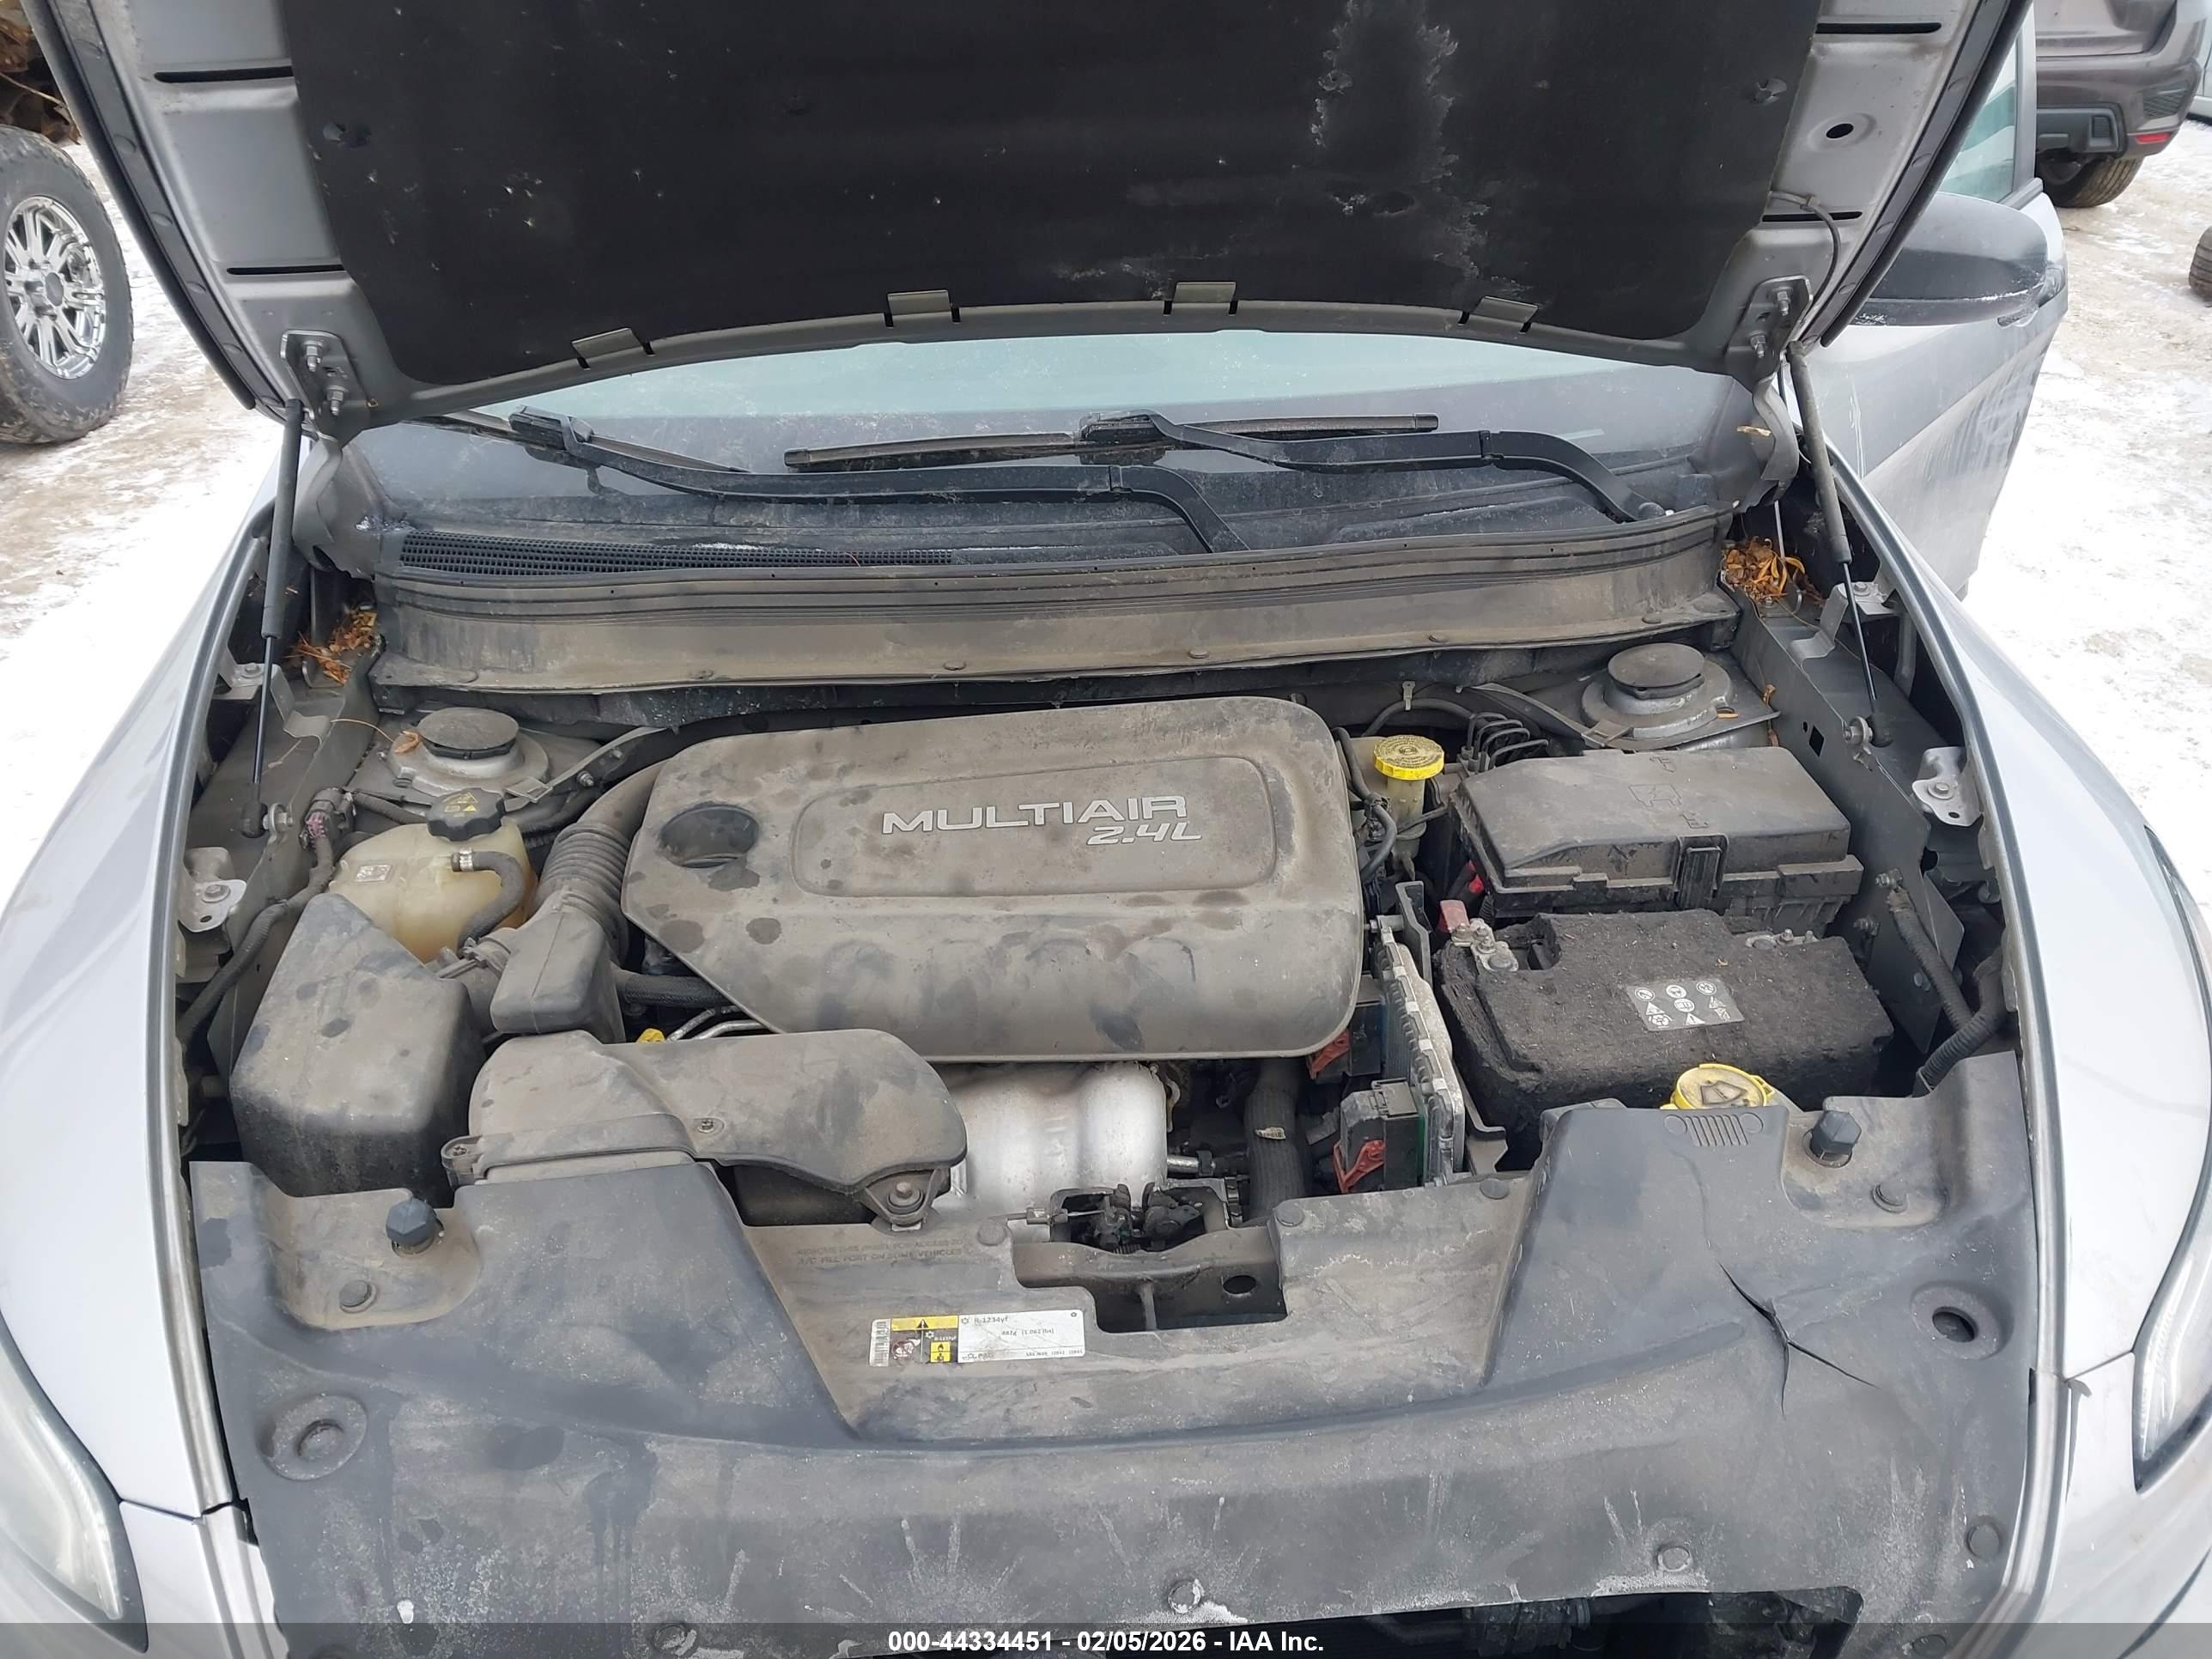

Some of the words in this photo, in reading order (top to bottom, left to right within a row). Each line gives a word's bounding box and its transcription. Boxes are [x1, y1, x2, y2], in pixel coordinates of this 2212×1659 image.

[881, 795, 1188, 835] MULTIAIR
[1085, 821, 1203, 846] 2.4L
[917, 1248, 963, 1259] VEHICLES
[975, 1316, 1009, 1325] R-1234yf
